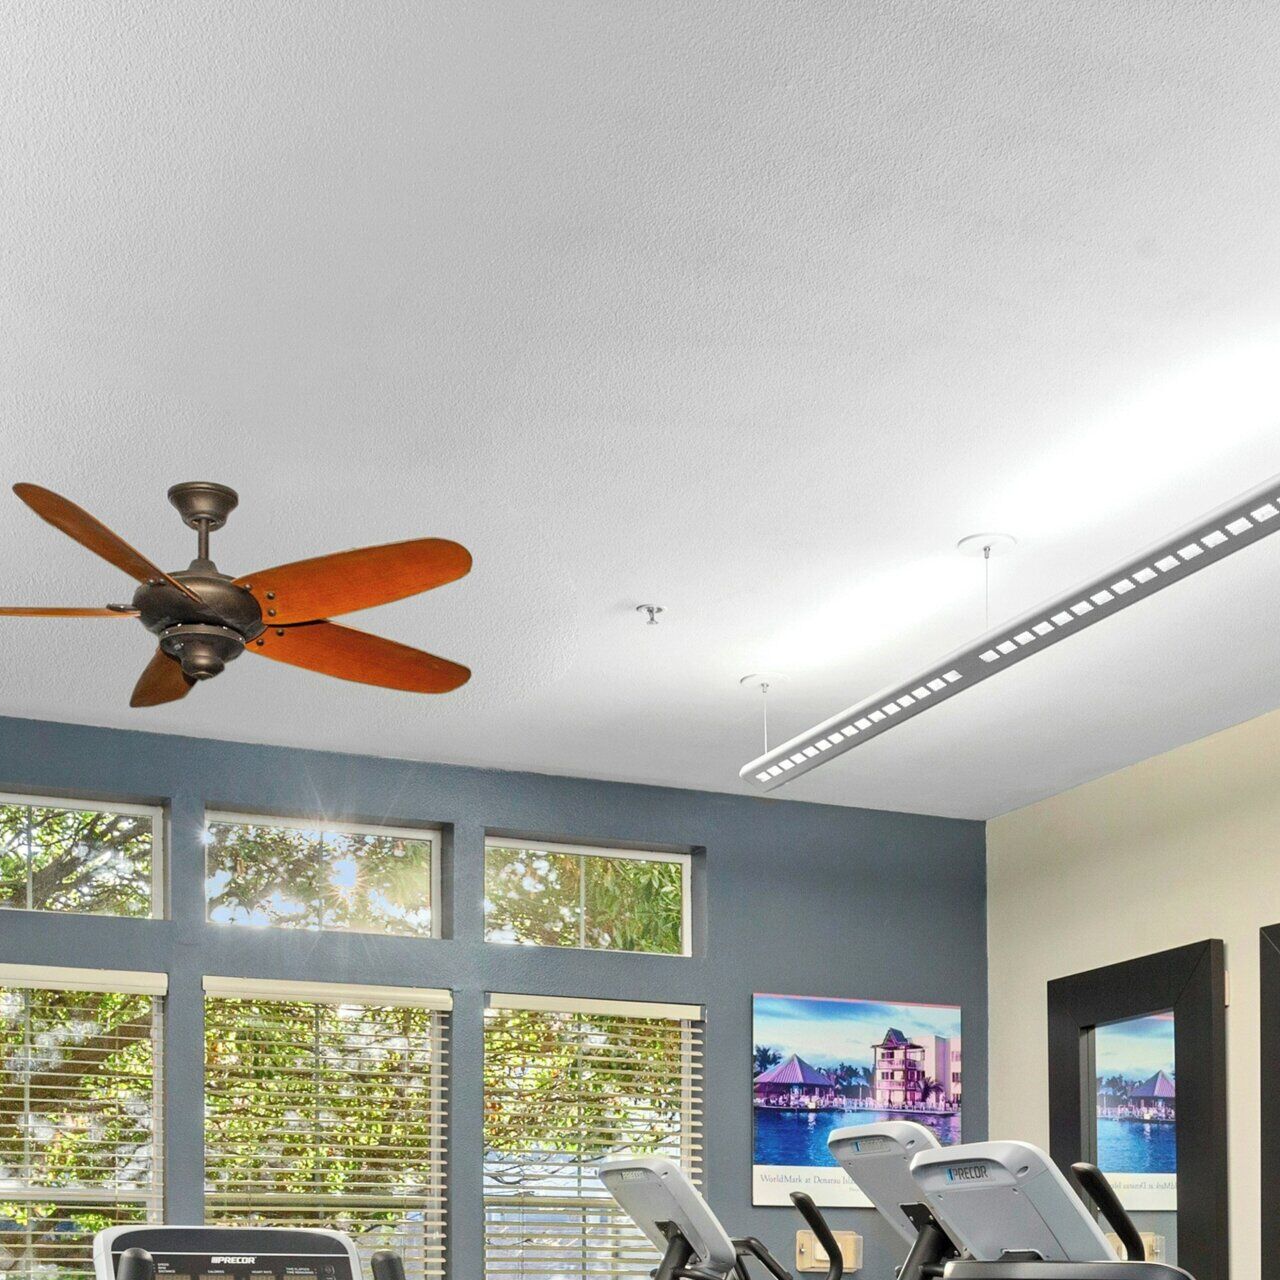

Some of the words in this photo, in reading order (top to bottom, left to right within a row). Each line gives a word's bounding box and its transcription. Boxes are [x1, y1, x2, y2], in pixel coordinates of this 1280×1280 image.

[952, 1165, 989, 1180] PRECOR
[760, 1174, 802, 1184] WorldMark
[218, 1256, 256, 1264] PRECOR
